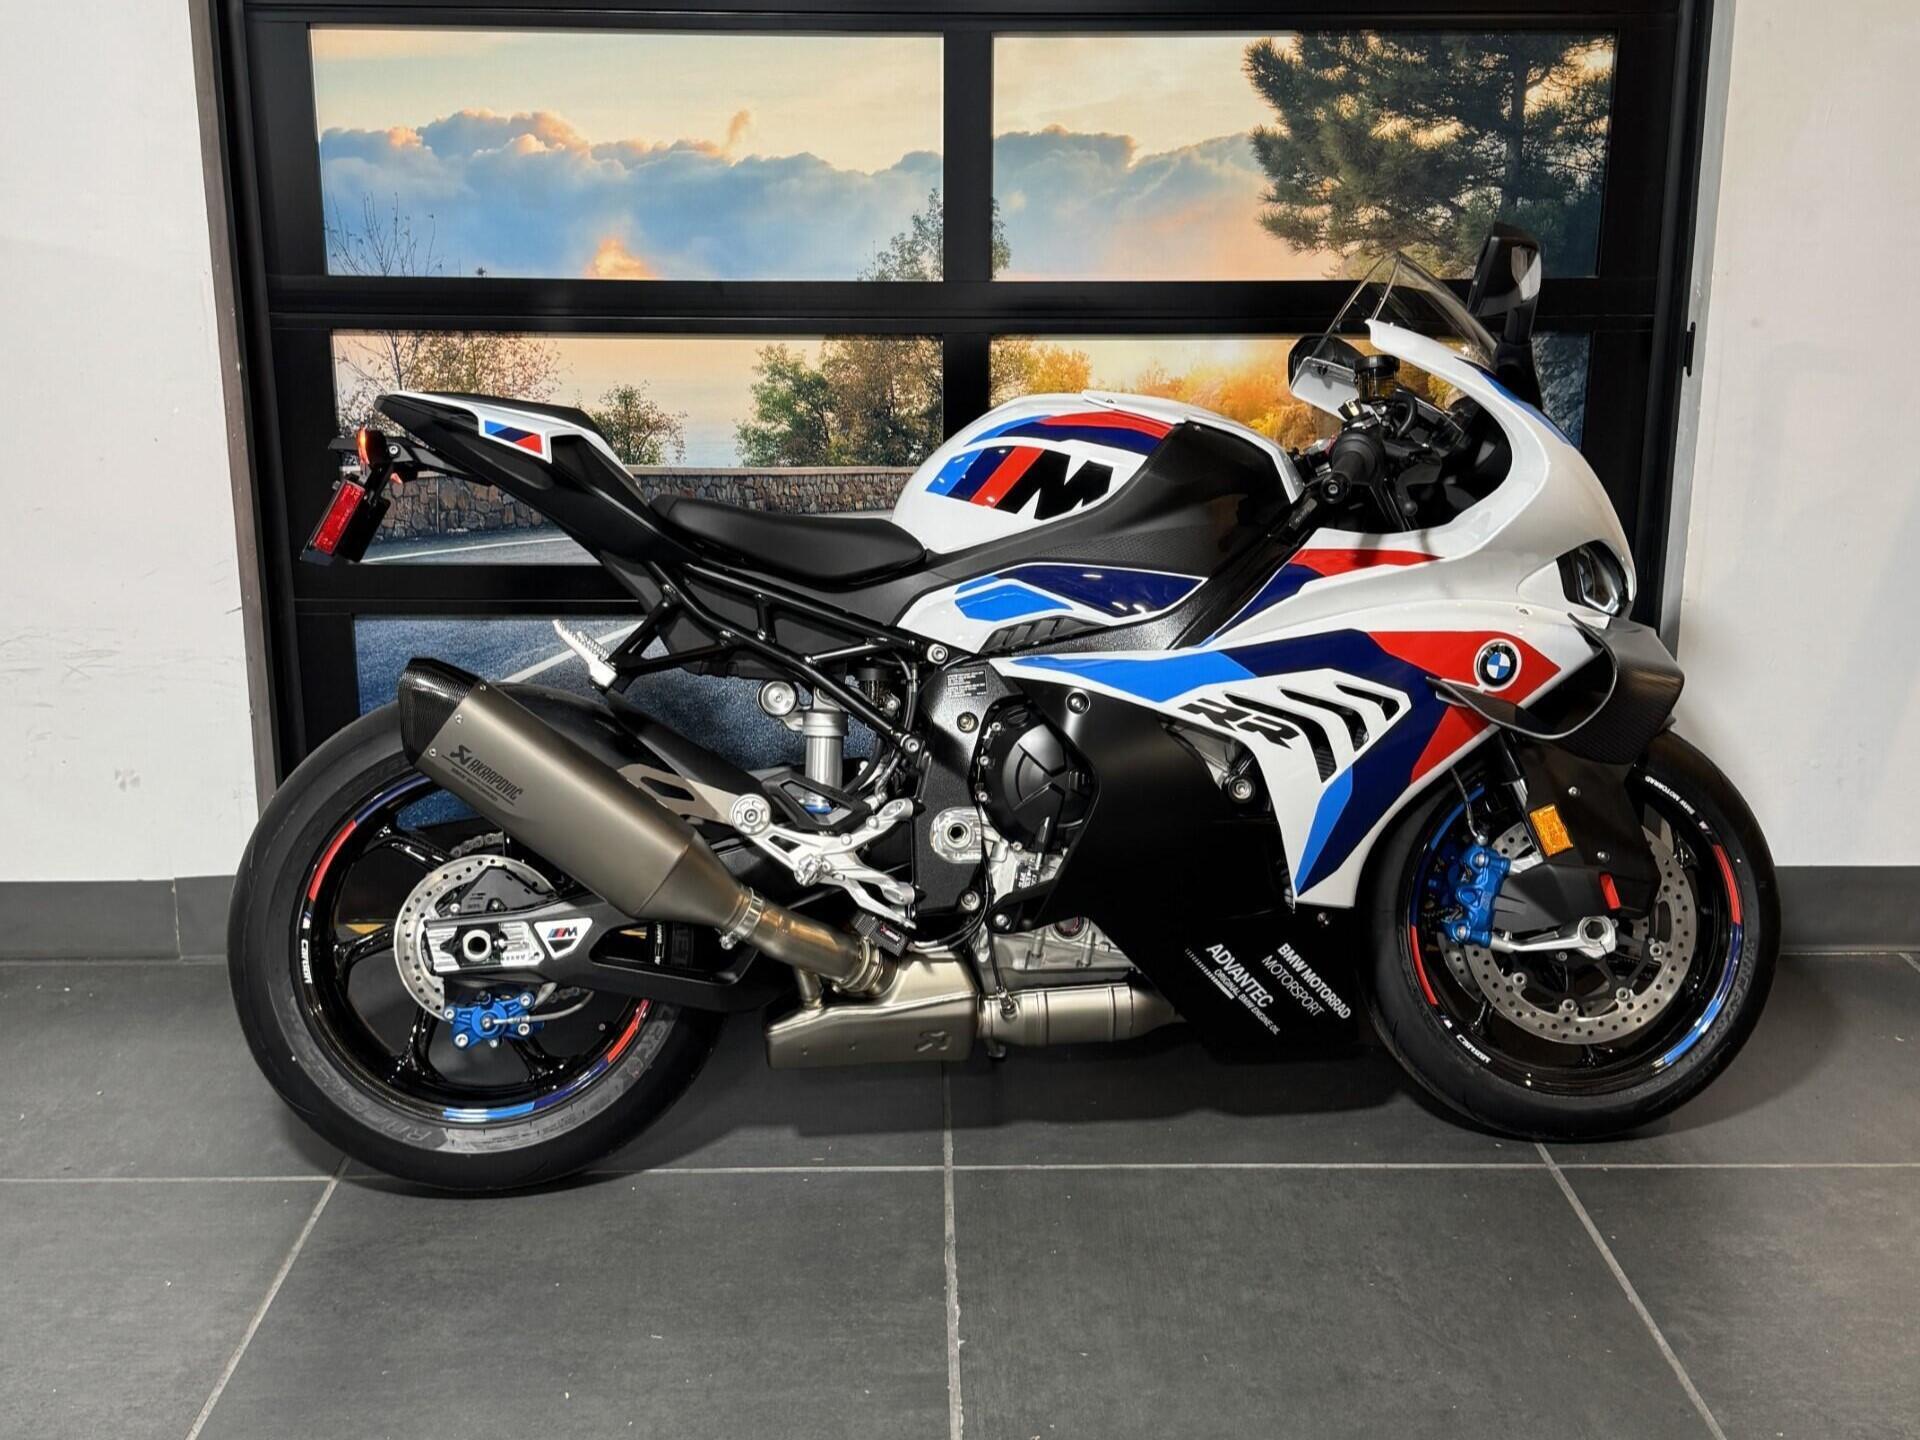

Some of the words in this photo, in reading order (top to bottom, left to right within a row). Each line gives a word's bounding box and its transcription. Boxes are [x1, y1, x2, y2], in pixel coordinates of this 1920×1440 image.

[1178, 698, 1300, 750] RR
[1206, 943, 1274, 1008] ADVANTEC
[1214, 968, 1240, 997] ORIGINAL
[1238, 993, 1253, 1009] BMW
[1251, 1006, 1273, 1027] ENGINE
[1262, 955, 1325, 1016] MOTORSPORT
[1278, 943, 1308, 973] BMW
[1301, 967, 1351, 1019] MOTORRAD
